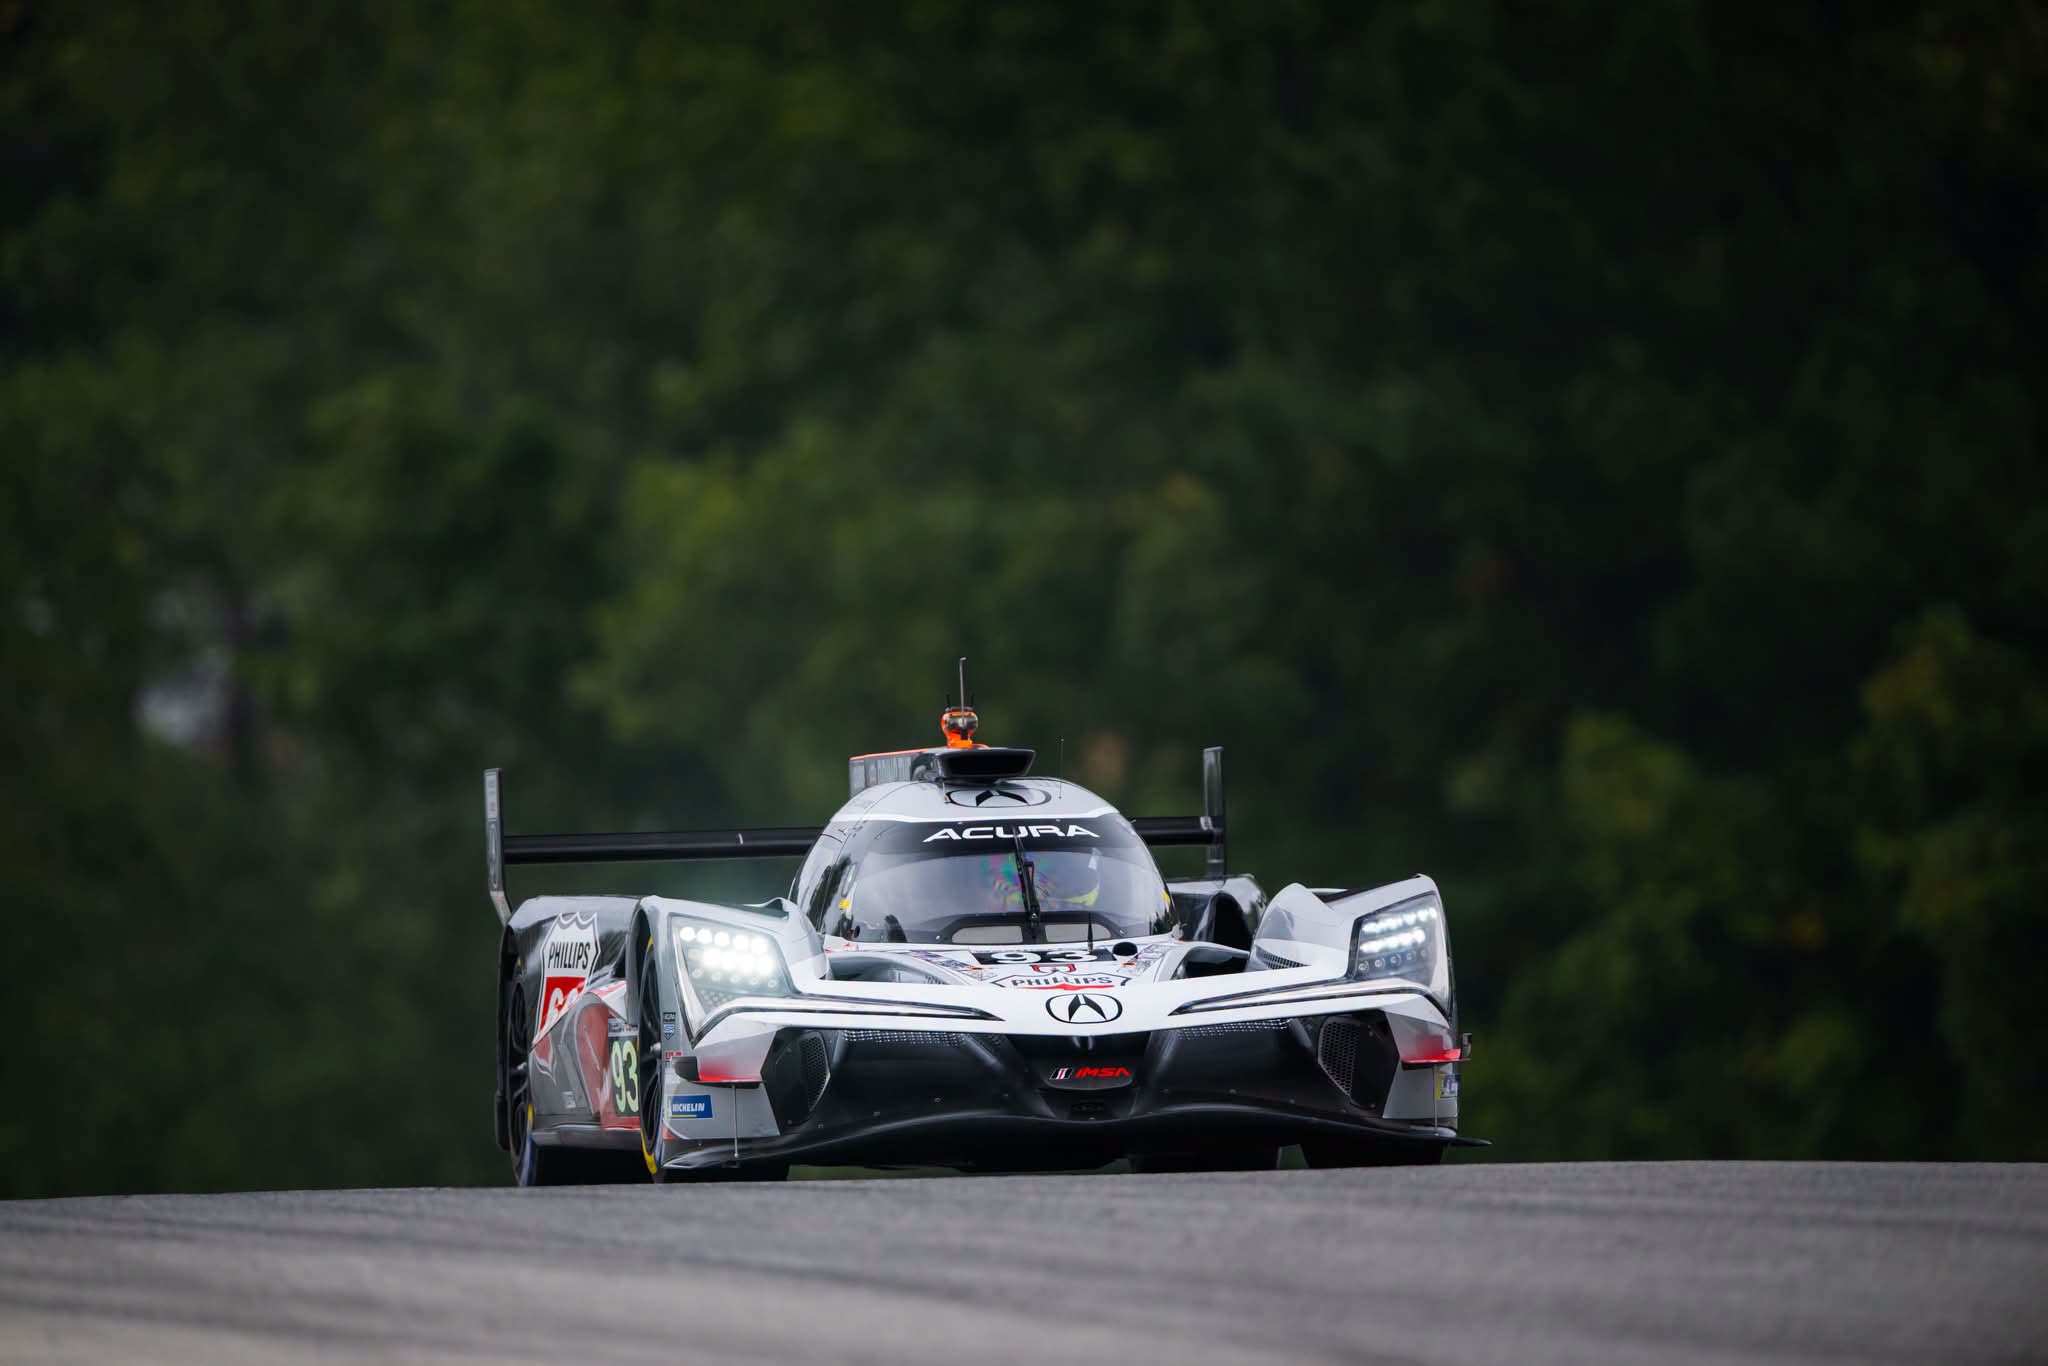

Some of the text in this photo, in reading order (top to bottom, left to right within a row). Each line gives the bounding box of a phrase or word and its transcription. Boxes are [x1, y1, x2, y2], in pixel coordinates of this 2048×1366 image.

[922, 825, 1101, 843] ACURA
[547, 941, 591, 970] PHILLIPS
[990, 950, 1099, 964] 93
[1011, 975, 1113, 987] PHILLIPS
[611, 1040, 639, 1113] 93
[1075, 1066, 1131, 1079] IMSA
[672, 1102, 705, 1113] MICHELIN
